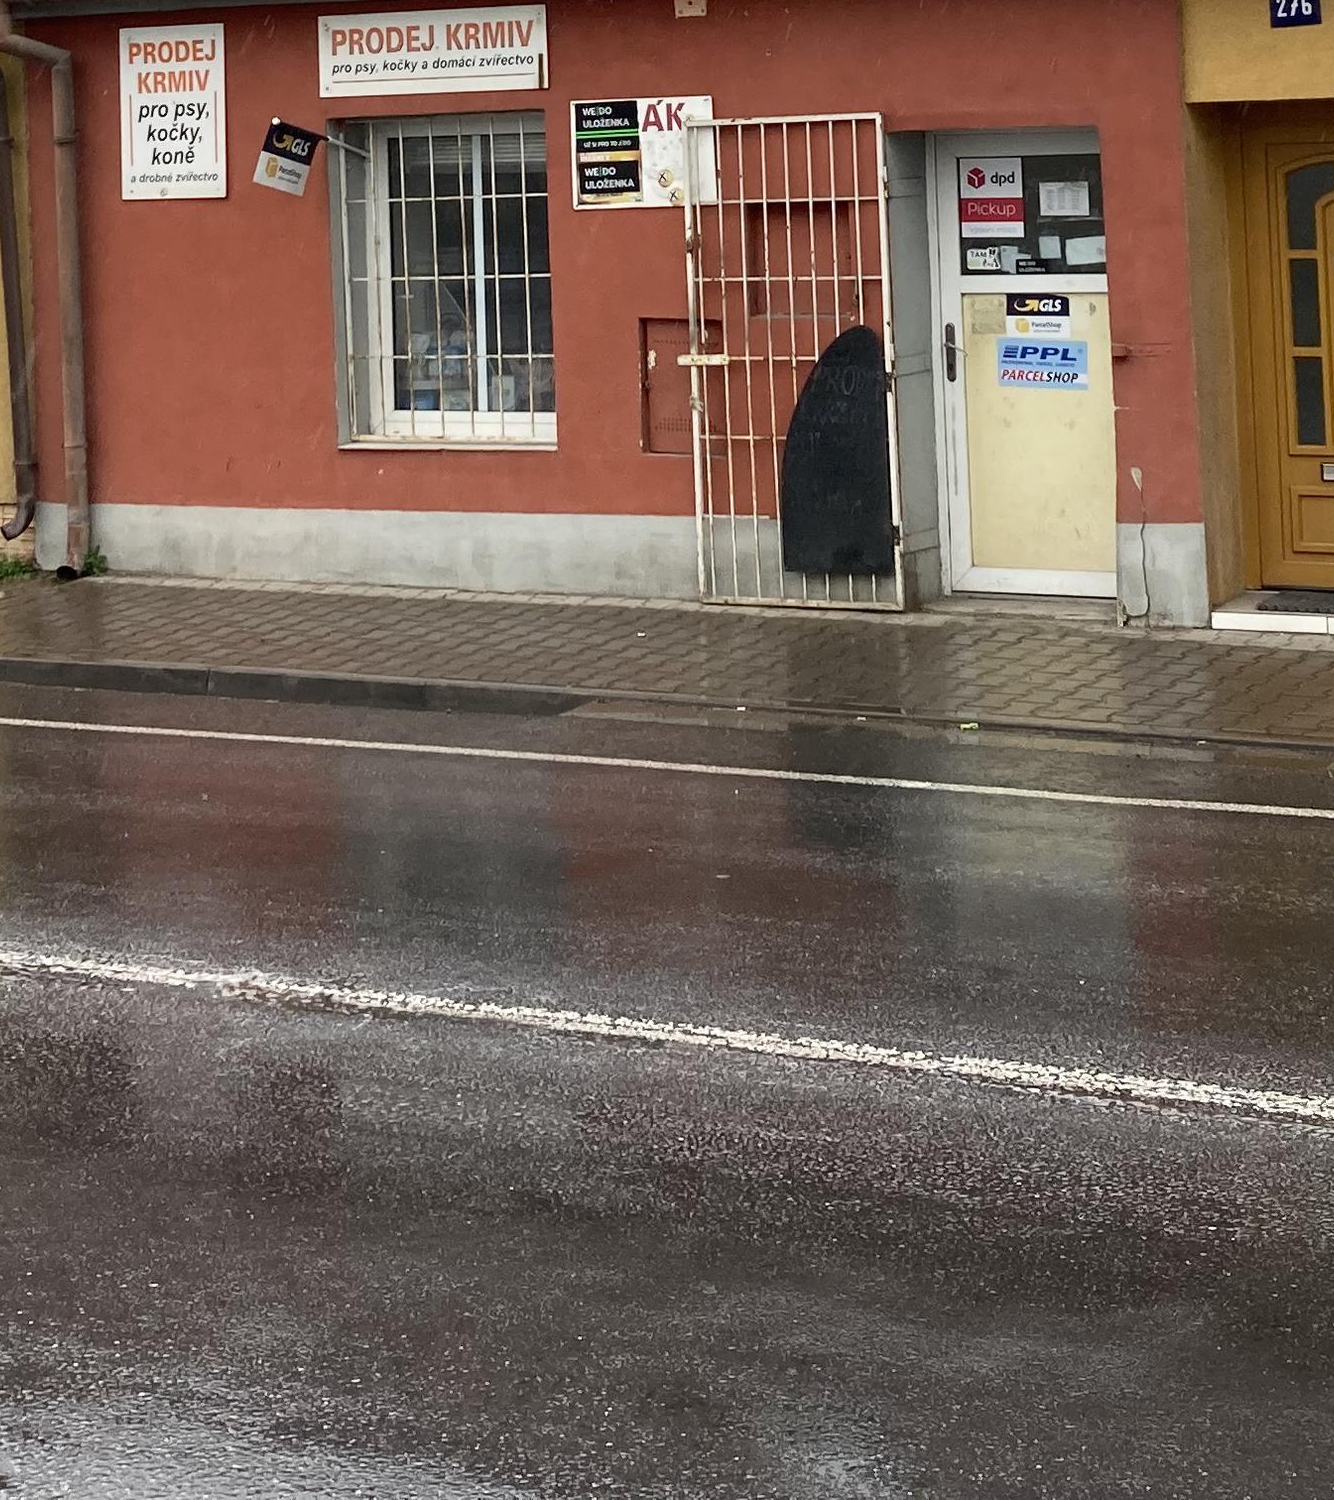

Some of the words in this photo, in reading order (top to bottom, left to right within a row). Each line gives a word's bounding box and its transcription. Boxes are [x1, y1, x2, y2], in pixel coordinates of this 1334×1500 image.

[331, 25, 435, 56] PRODEJ
[446, 20, 534, 50] KRMIV
[128, 39, 216, 64] PRODEJ
[332, 63, 352, 76] pro
[383, 58, 418, 73] kočky
[421, 61, 428, 70] a
[432, 56, 475, 70] domácí
[479, 53, 534, 67] zvířectvo
[137, 70, 210, 94] KRMIV
[138, 103, 168, 123] pro
[174, 102, 210, 121] psy,
[582, 118, 631, 129] ULOŽENKA
[146, 123, 203, 145] kočky,
[291, 138, 312, 156] GLS
[151, 146, 195, 166] koně
[130, 175, 137, 183] a
[139, 173, 173, 183] drobné
[175, 172, 219, 183] zvířectvo
[585, 178, 635, 190] ULOŽENKA
[990, 171, 1015, 187] dpd
[968, 202, 1016, 217] Pickup
[1039, 299, 1062, 312] GLS
[1019, 346, 1077, 361] PPL
[1001, 369, 1079, 383] PARCELSHOP
